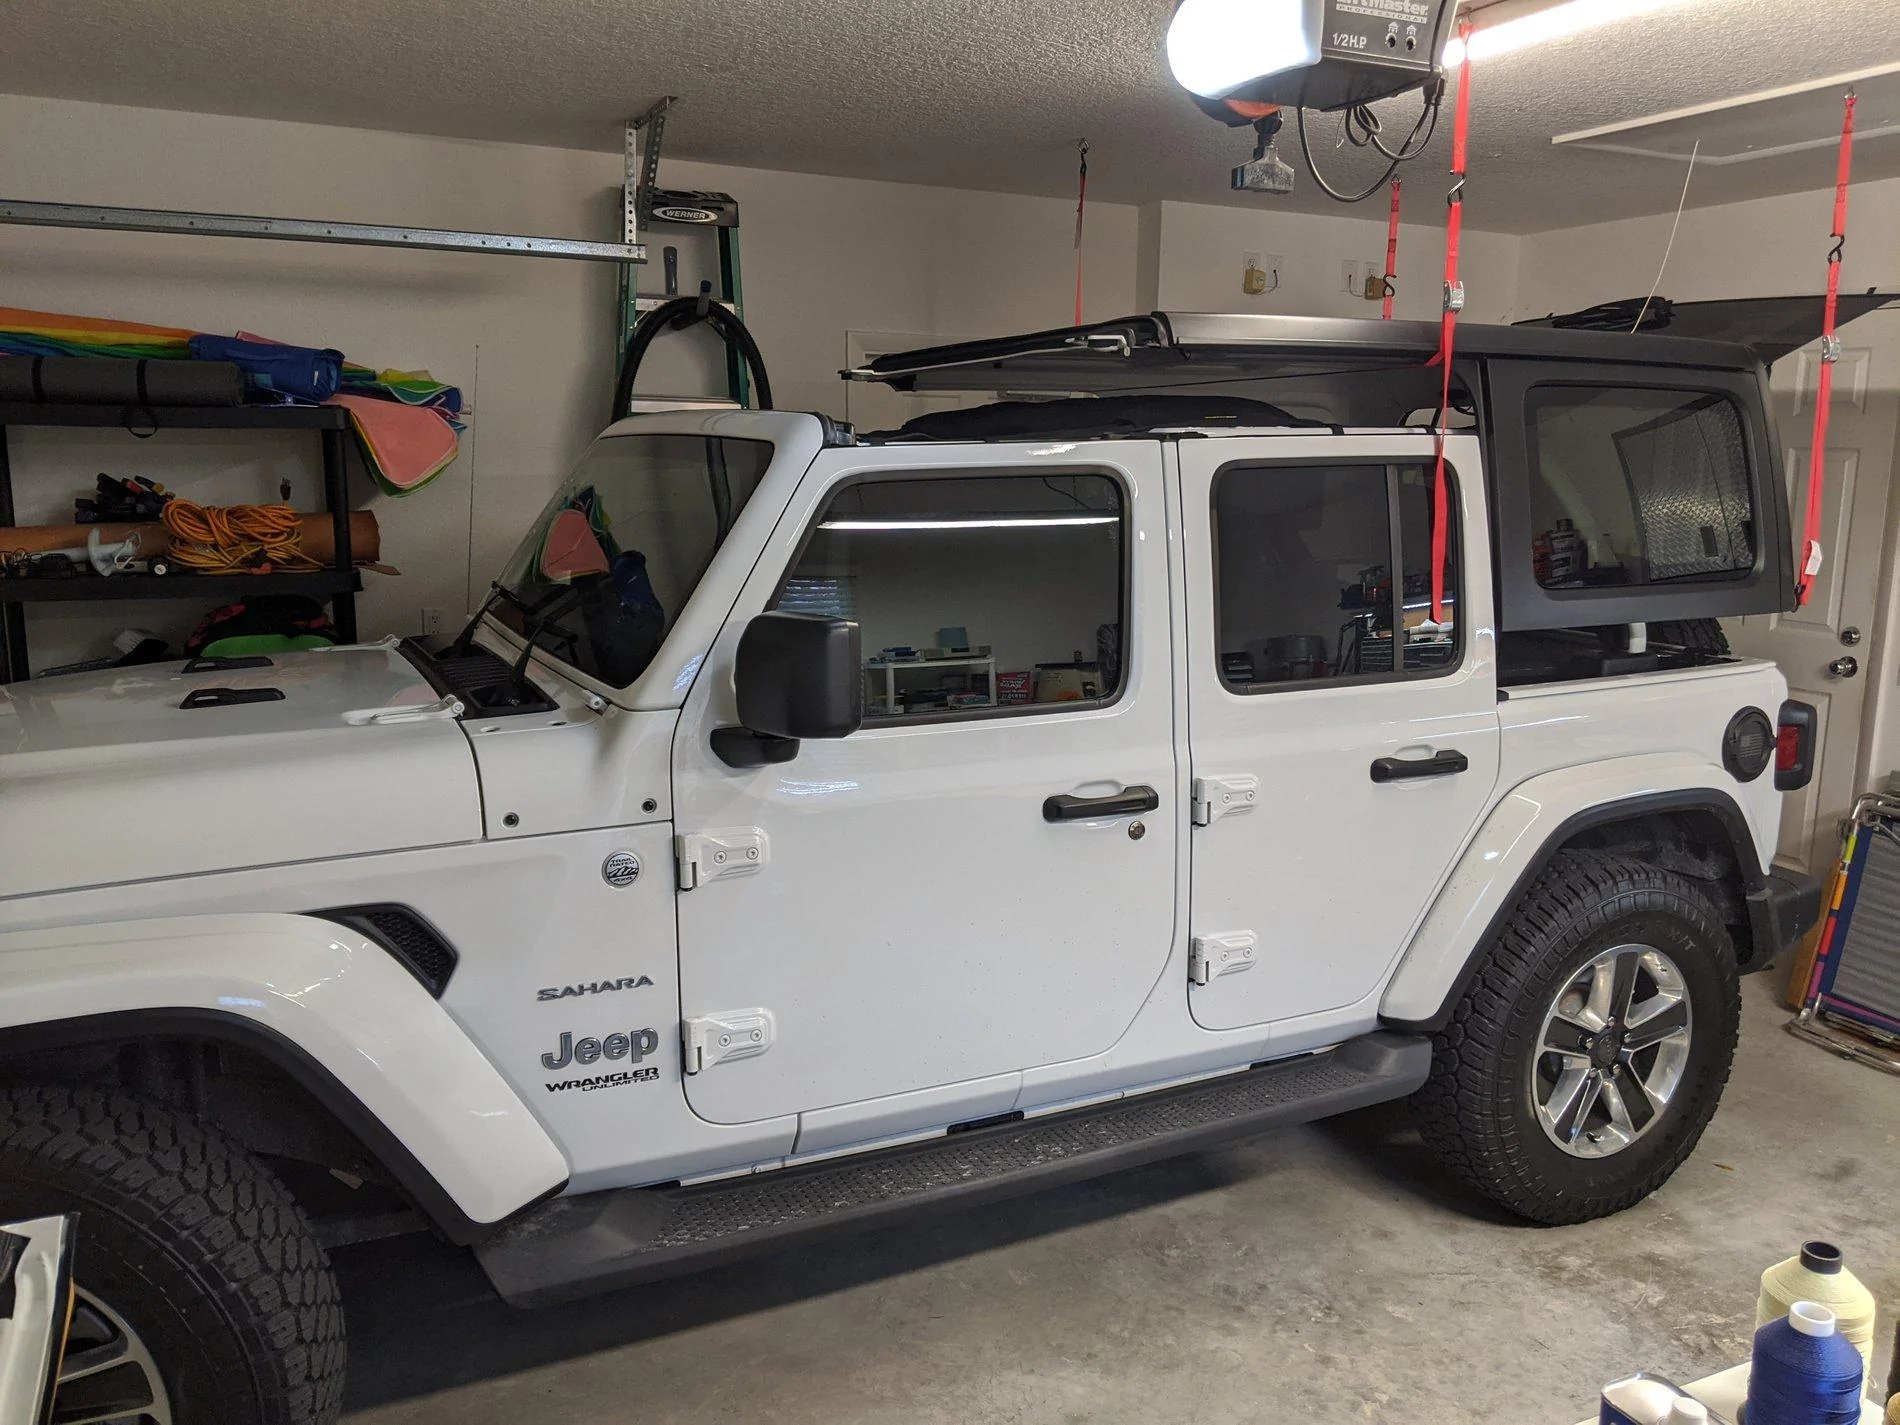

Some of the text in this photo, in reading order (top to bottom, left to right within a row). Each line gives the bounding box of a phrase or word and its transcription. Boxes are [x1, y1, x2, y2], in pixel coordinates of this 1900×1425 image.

[1336, 0, 1429, 15] Master
[1337, 4, 1428, 23] PROFESSIONAL
[665, 209, 706, 220] WERNER
[609, 860, 635, 868] RATED
[537, 975, 655, 1002] SAHARA
[541, 1027, 659, 1071] Jeep
[545, 1066, 659, 1093] WRANGLER
[582, 1075, 660, 1092] UNLIMITED
